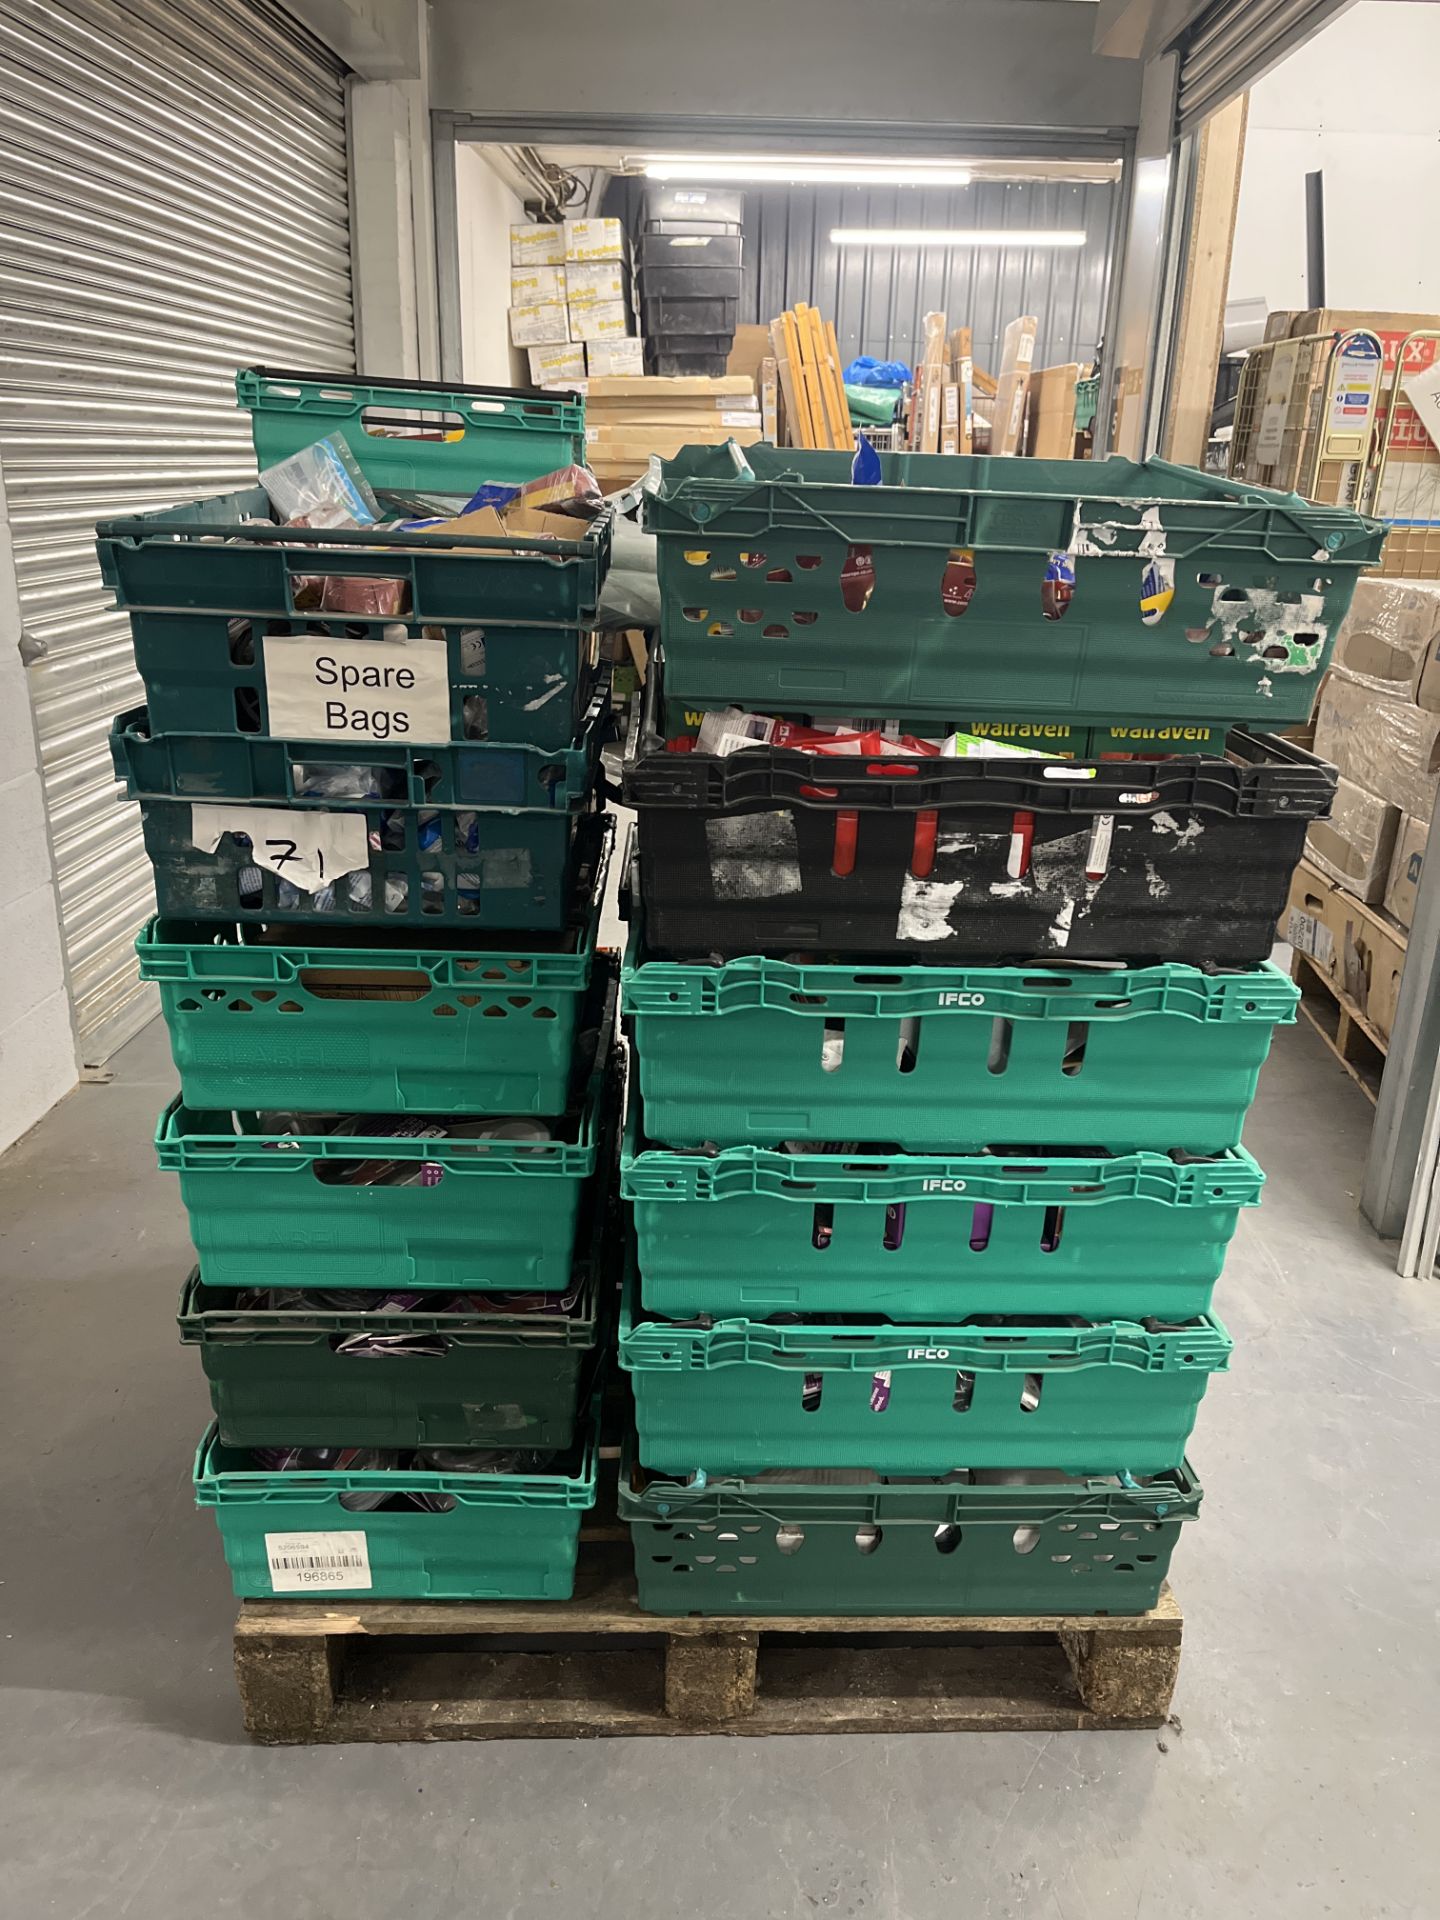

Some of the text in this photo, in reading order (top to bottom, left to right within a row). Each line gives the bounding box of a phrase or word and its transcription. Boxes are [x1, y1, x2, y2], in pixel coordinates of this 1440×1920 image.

[315, 656, 415, 692] Spare
[326, 701, 410, 739] Bags
[971, 722, 1071, 737] walraven
[938, 992, 985, 1006] IFCO
[923, 1179, 967, 1191] IFCO
[907, 1349, 950, 1360] IFCO
